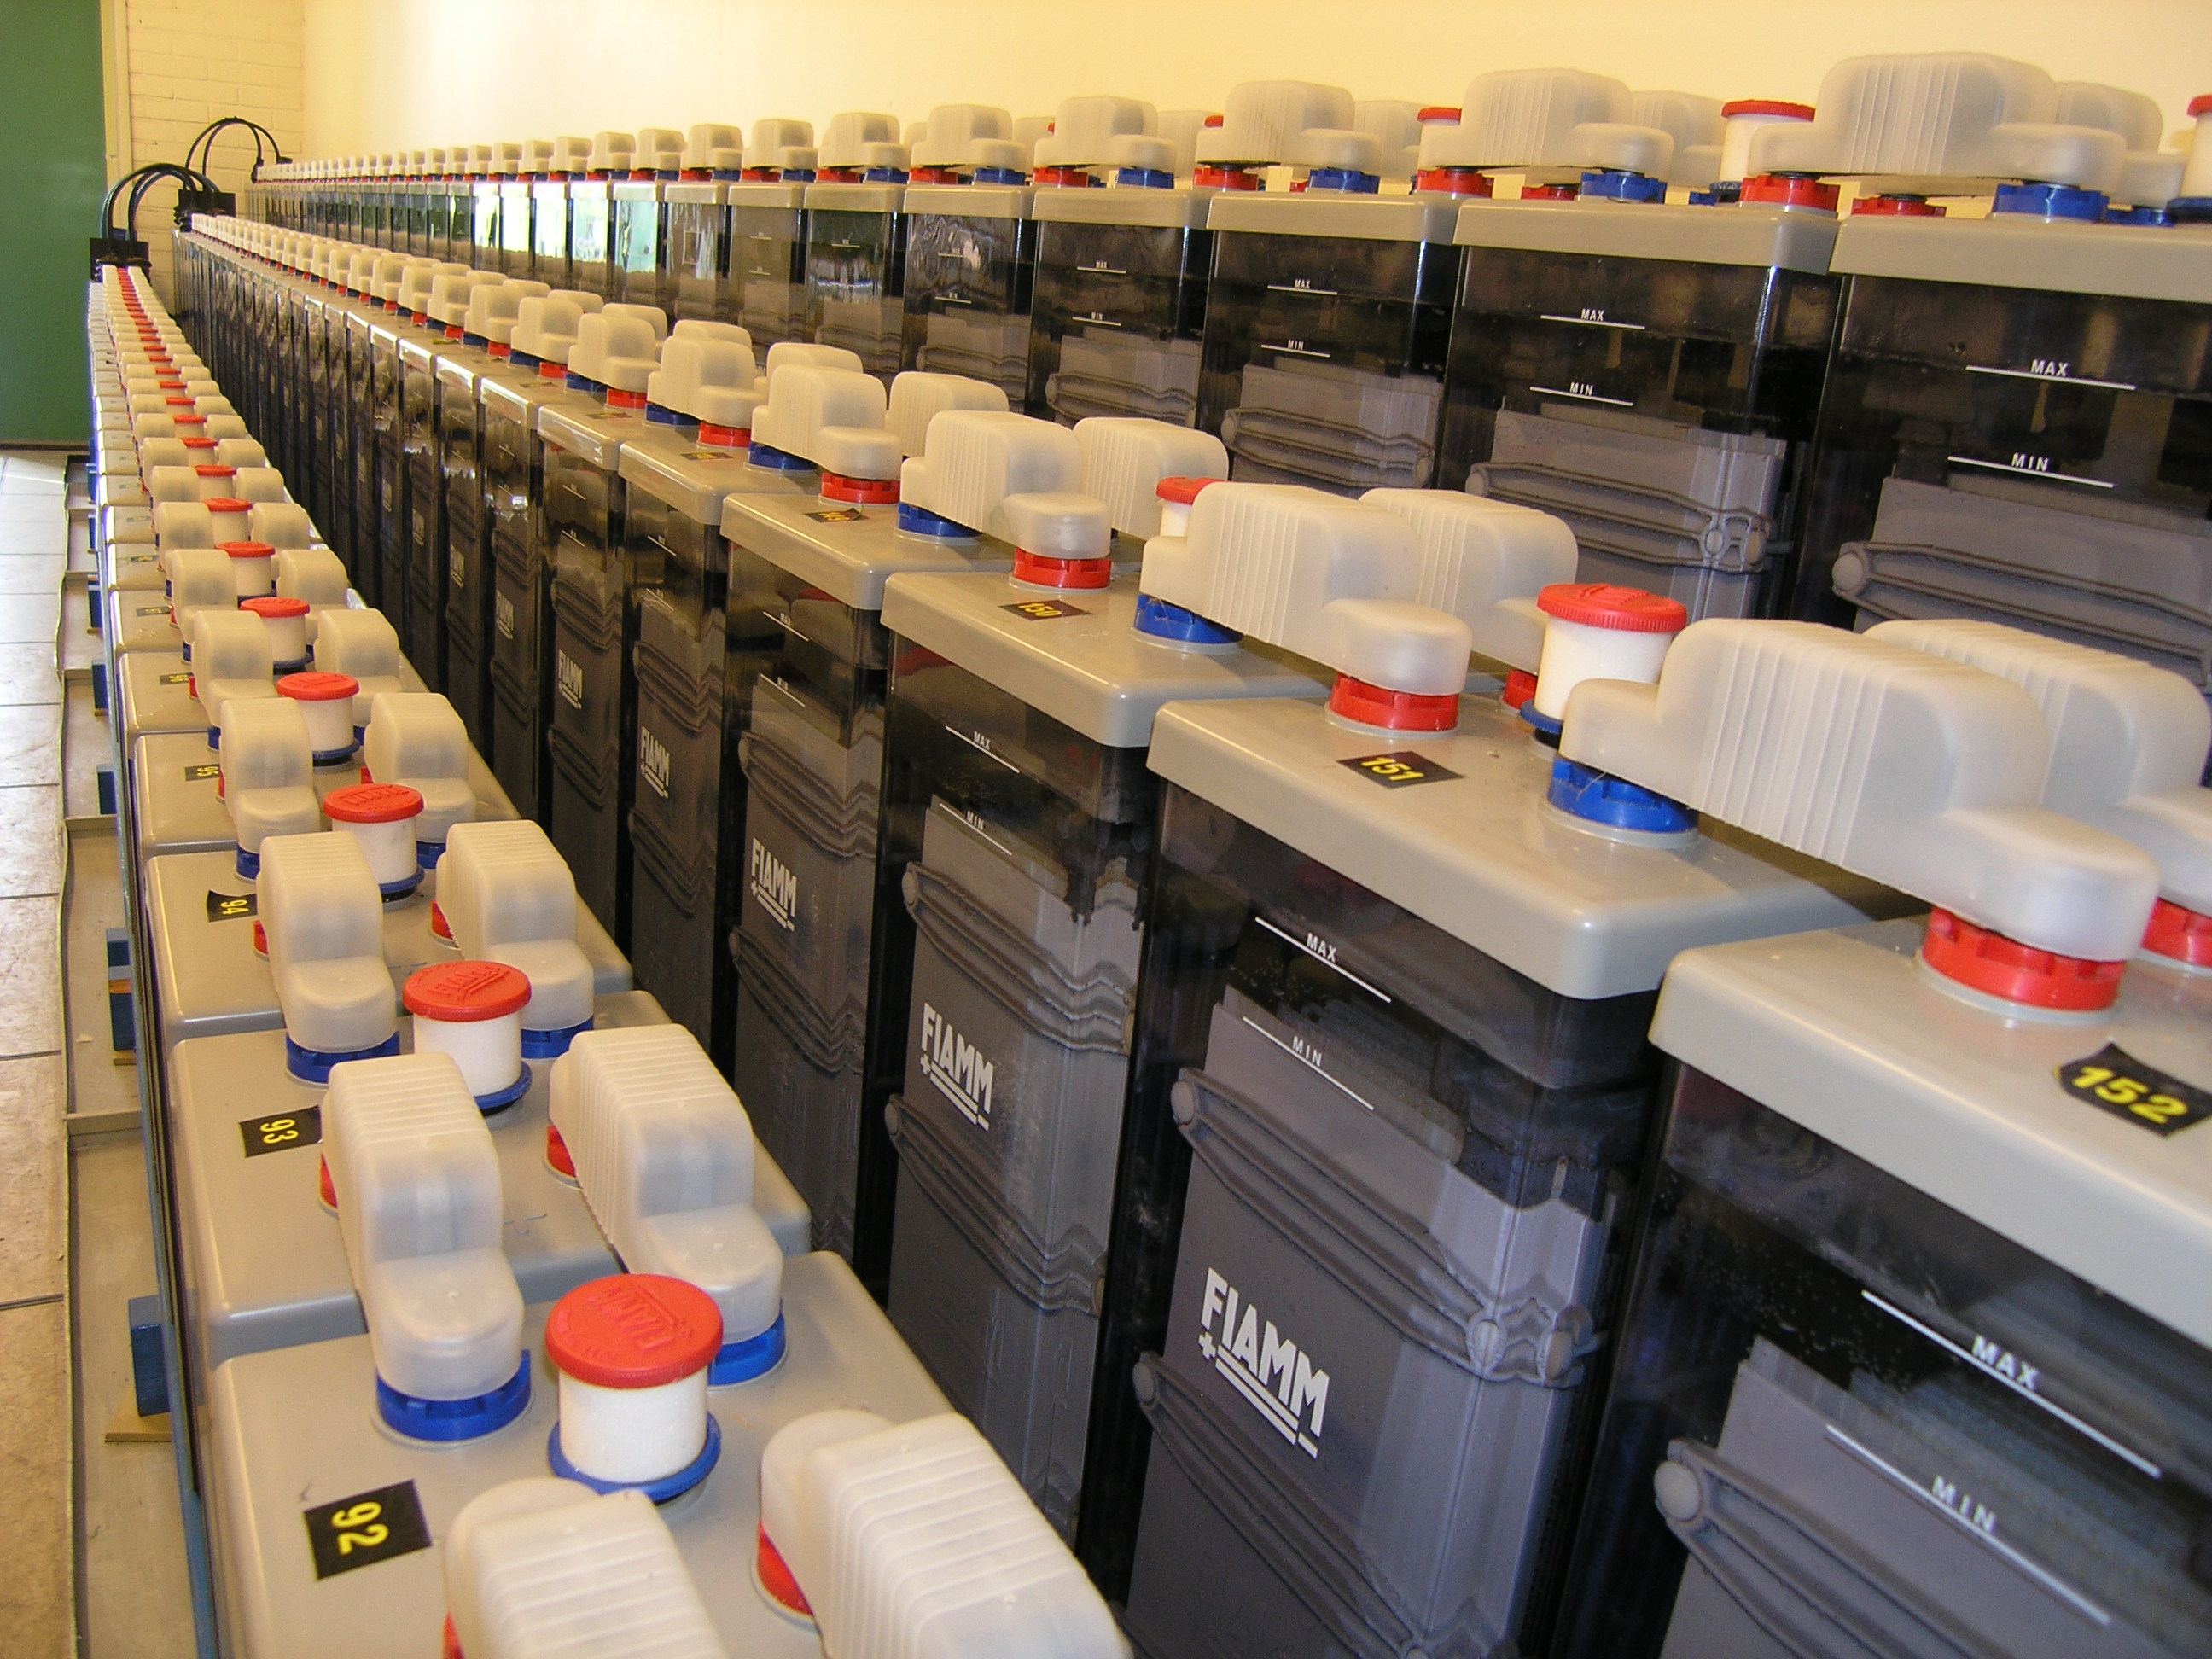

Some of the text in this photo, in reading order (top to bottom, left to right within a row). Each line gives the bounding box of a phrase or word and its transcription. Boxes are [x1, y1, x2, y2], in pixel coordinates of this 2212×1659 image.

[1295, 279, 1311, 289] MAX
[1580, 308, 1604, 322] MAX
[1287, 339, 1304, 350] MIN
[2030, 358, 2069, 377] MAX
[1569, 382, 1593, 396] MIN
[2011, 452, 2049, 472] MIN
[1018, 602, 1063, 617] 150
[974, 731, 991, 750] MAX
[1361, 757, 1426, 782] 151
[967, 811, 984, 830] MIN
[752, 837, 797, 917] FIAMM
[220, 899, 249, 916] 94
[1306, 933, 1337, 963] MAX
[921, 1002, 994, 1115] FIAMM
[1292, 1035, 1322, 1067] MIN
[2071, 1066, 2188, 1125] 152
[259, 1119, 299, 1144] 93
[1202, 1266, 1330, 1438] FIAMM
[1971, 1335, 2039, 1391] MAX
[1931, 1475, 1996, 1534] MIN
[331, 1501, 389, 1556] 92
